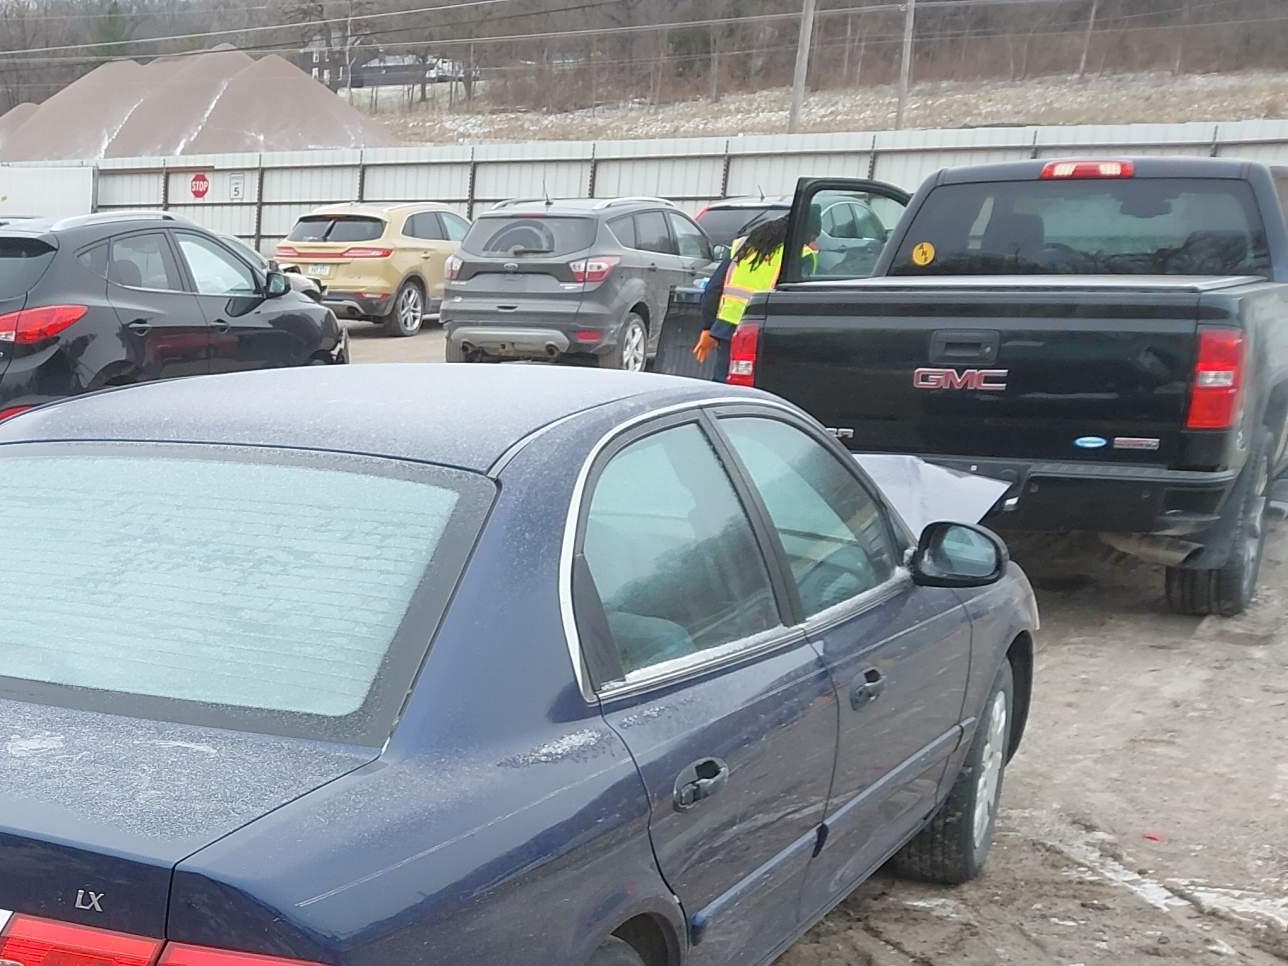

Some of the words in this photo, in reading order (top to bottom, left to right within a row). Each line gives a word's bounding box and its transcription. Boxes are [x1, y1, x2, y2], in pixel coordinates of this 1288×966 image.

[192, 181, 208, 192] STOP
[234, 187, 240, 197] 5
[913, 367, 1009, 390] GMC
[75, 889, 105, 912] LX
